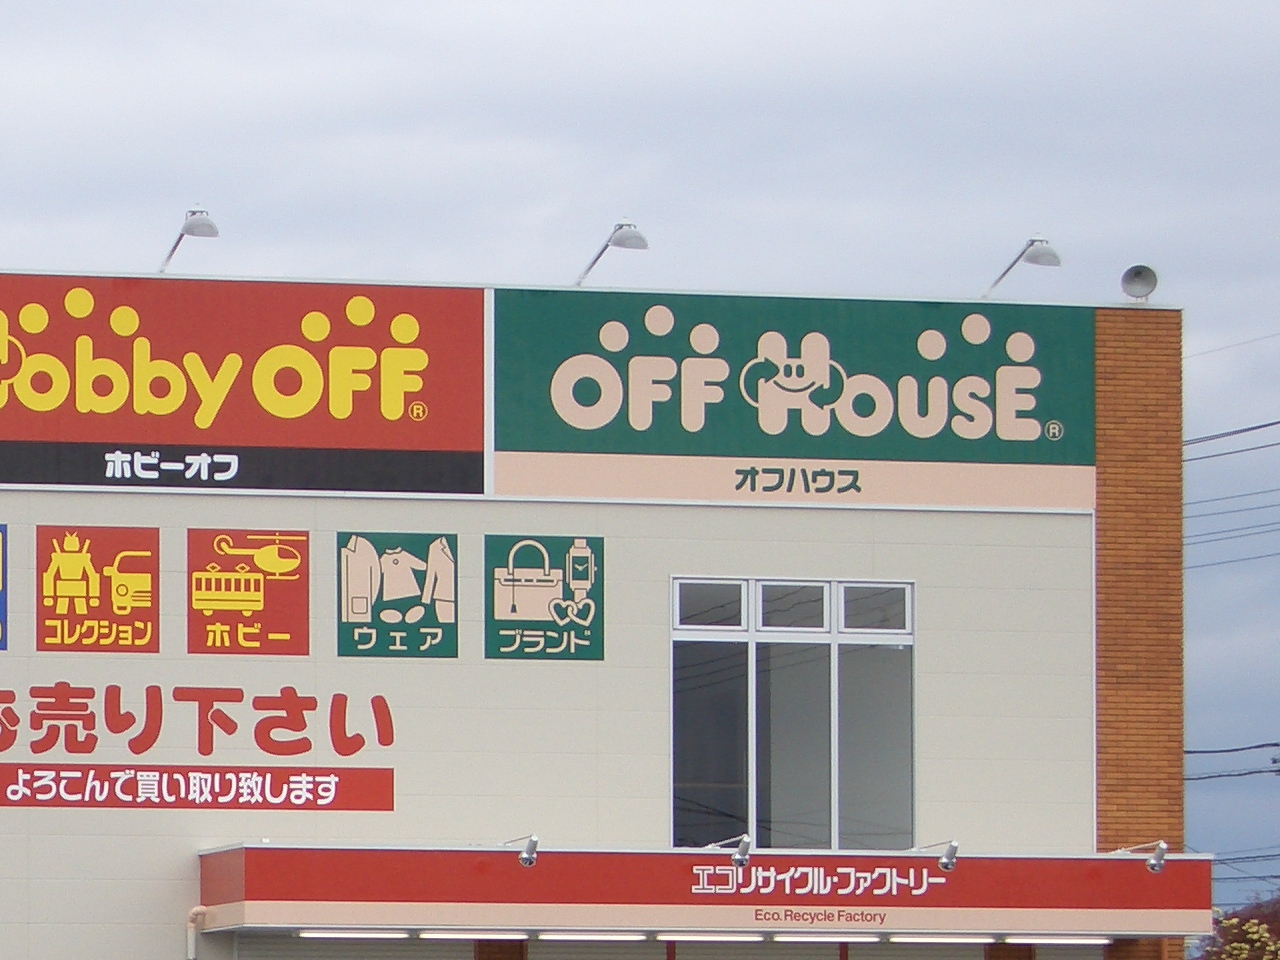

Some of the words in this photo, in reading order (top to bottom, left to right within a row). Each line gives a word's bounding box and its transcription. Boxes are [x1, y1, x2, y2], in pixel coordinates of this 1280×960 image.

[550, 353, 730, 433] OFF
[105, 450, 240, 481] ホビーオフ
[735, 467, 862, 494] オフハウス
[44, 619, 152, 646] コレクション
[205, 622, 291, 648] ホビー
[498, 629, 591, 654] ブランド
[6, 769, 340, 805] よろこんで買い取り致します
[691, 865, 947, 896] エコリサイクル・ファクトリー
[784, 909, 835, 925] Recycle
[837, 910, 887, 925] Factory
